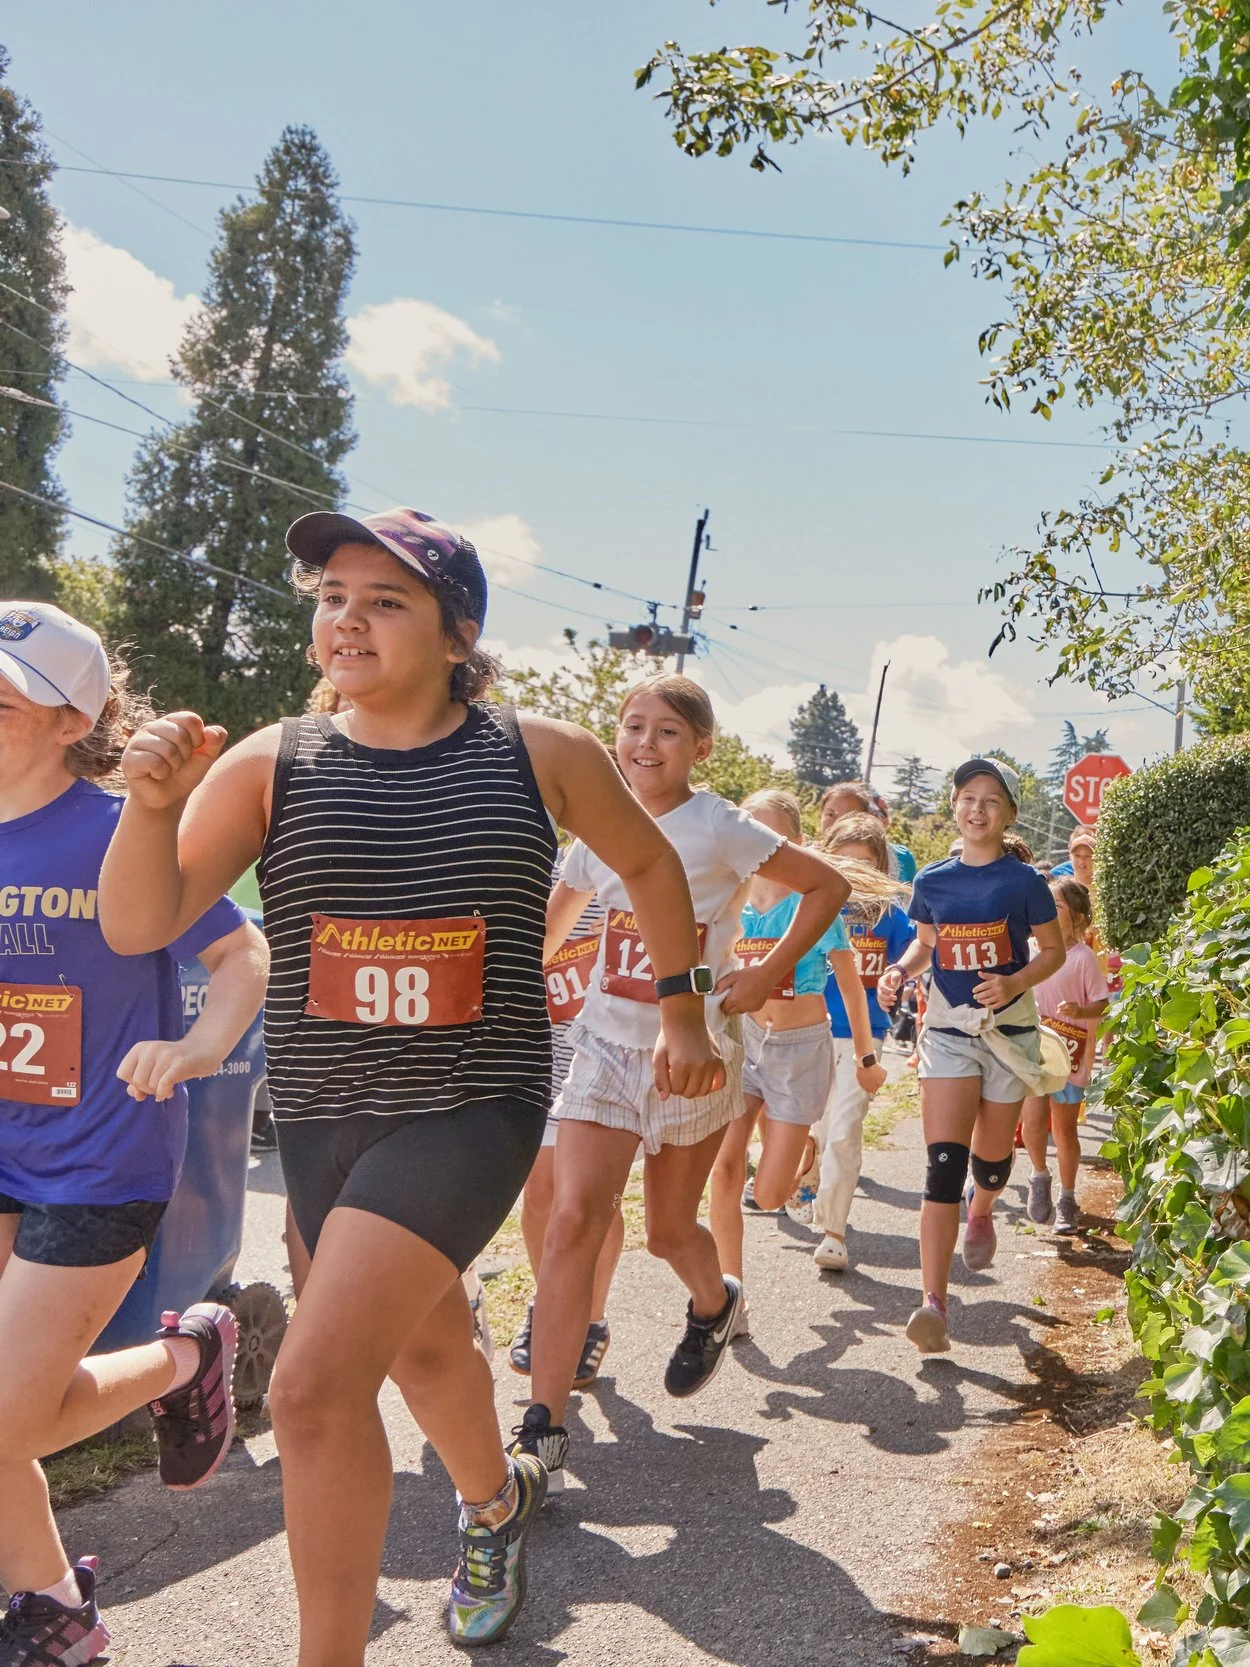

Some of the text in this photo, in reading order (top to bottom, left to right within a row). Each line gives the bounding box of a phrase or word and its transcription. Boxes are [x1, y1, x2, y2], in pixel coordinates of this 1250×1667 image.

[316, 923, 474, 951] Athletic NET
[939, 925, 988, 937] Athletic
[952, 941, 998, 971] 113
[355, 966, 430, 1025] 98
[547, 966, 585, 1006] 91
[28, 998, 67, 1009] NET
